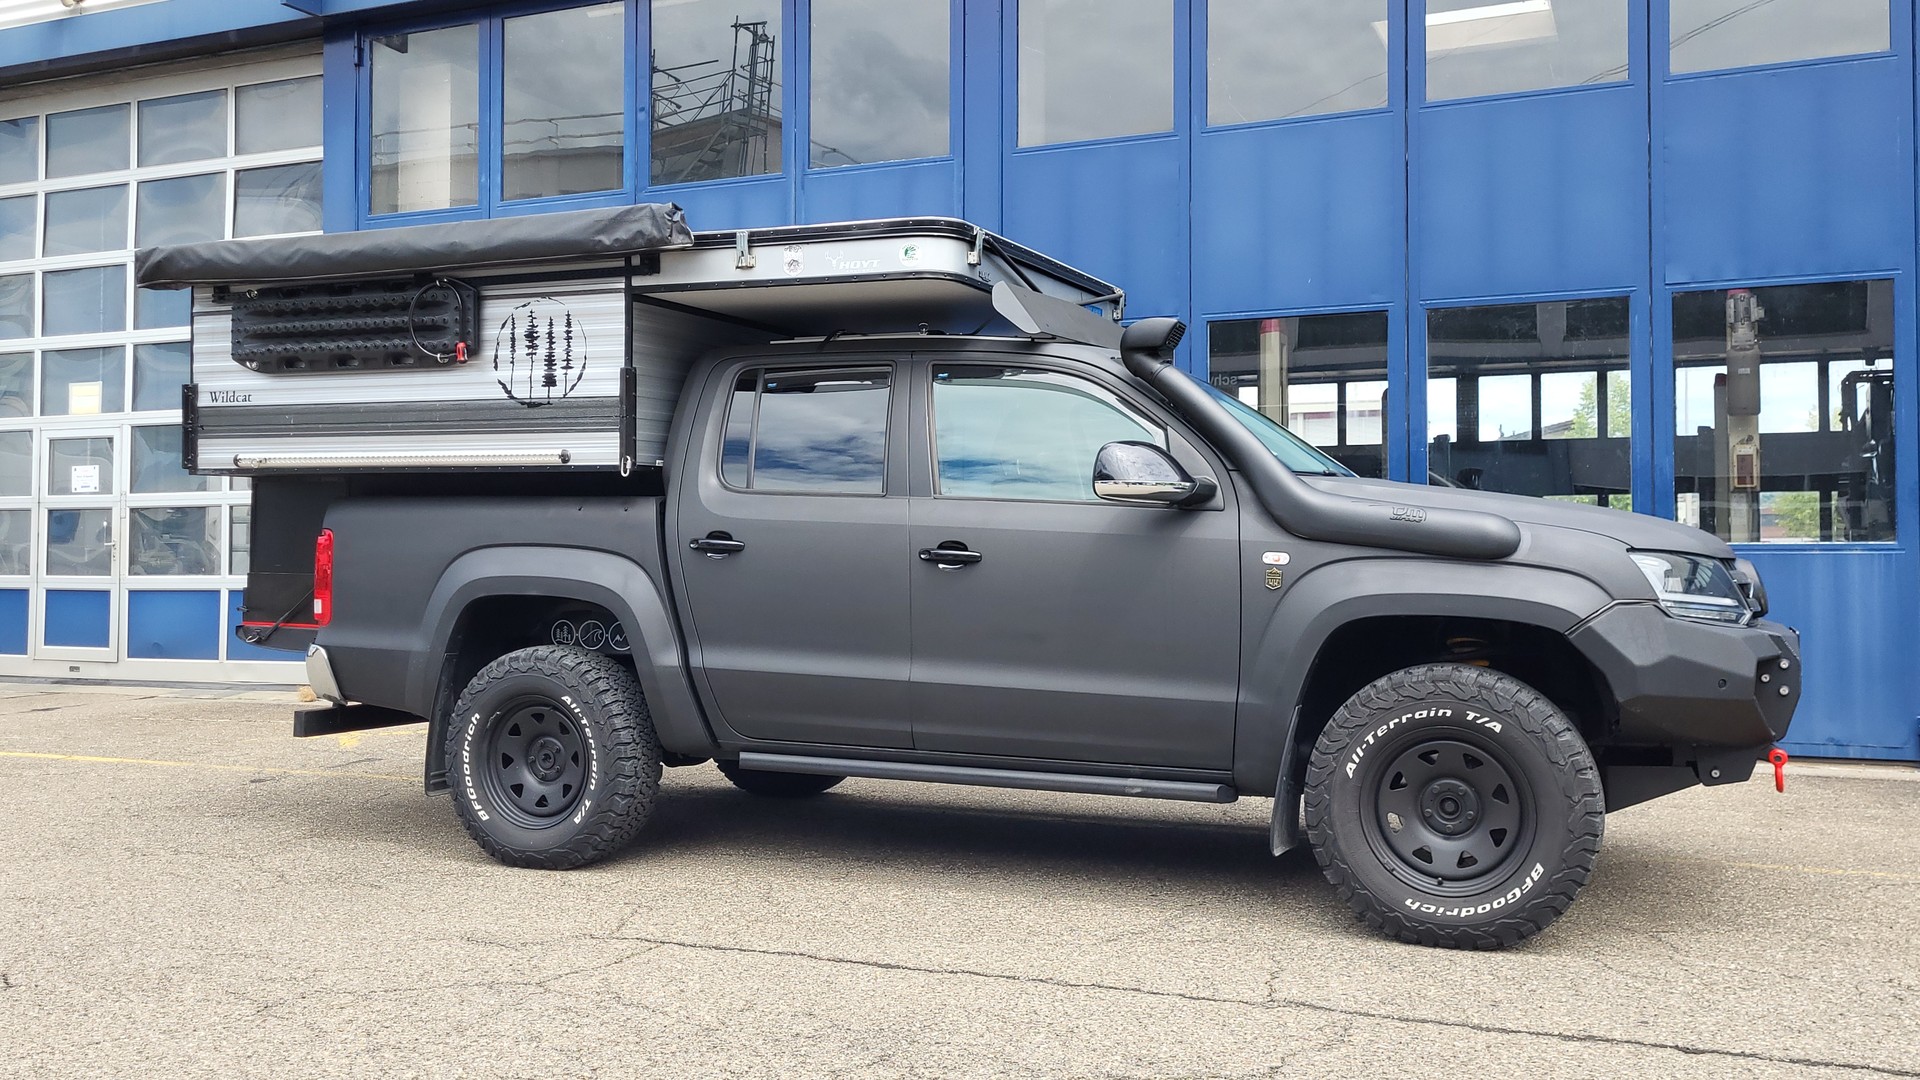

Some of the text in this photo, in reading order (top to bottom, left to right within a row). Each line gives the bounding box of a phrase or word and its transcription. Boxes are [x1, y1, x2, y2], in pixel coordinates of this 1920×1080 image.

[839, 259, 881, 270] HOYT
[210, 390, 252, 403] Wildcat
[462, 712, 490, 821] BFGoodrich
[561, 695, 597, 824] All-Terrain T/A
[1345, 707, 1503, 779] All-Terrain T/A
[1404, 862, 1545, 918] BFGoodrich
